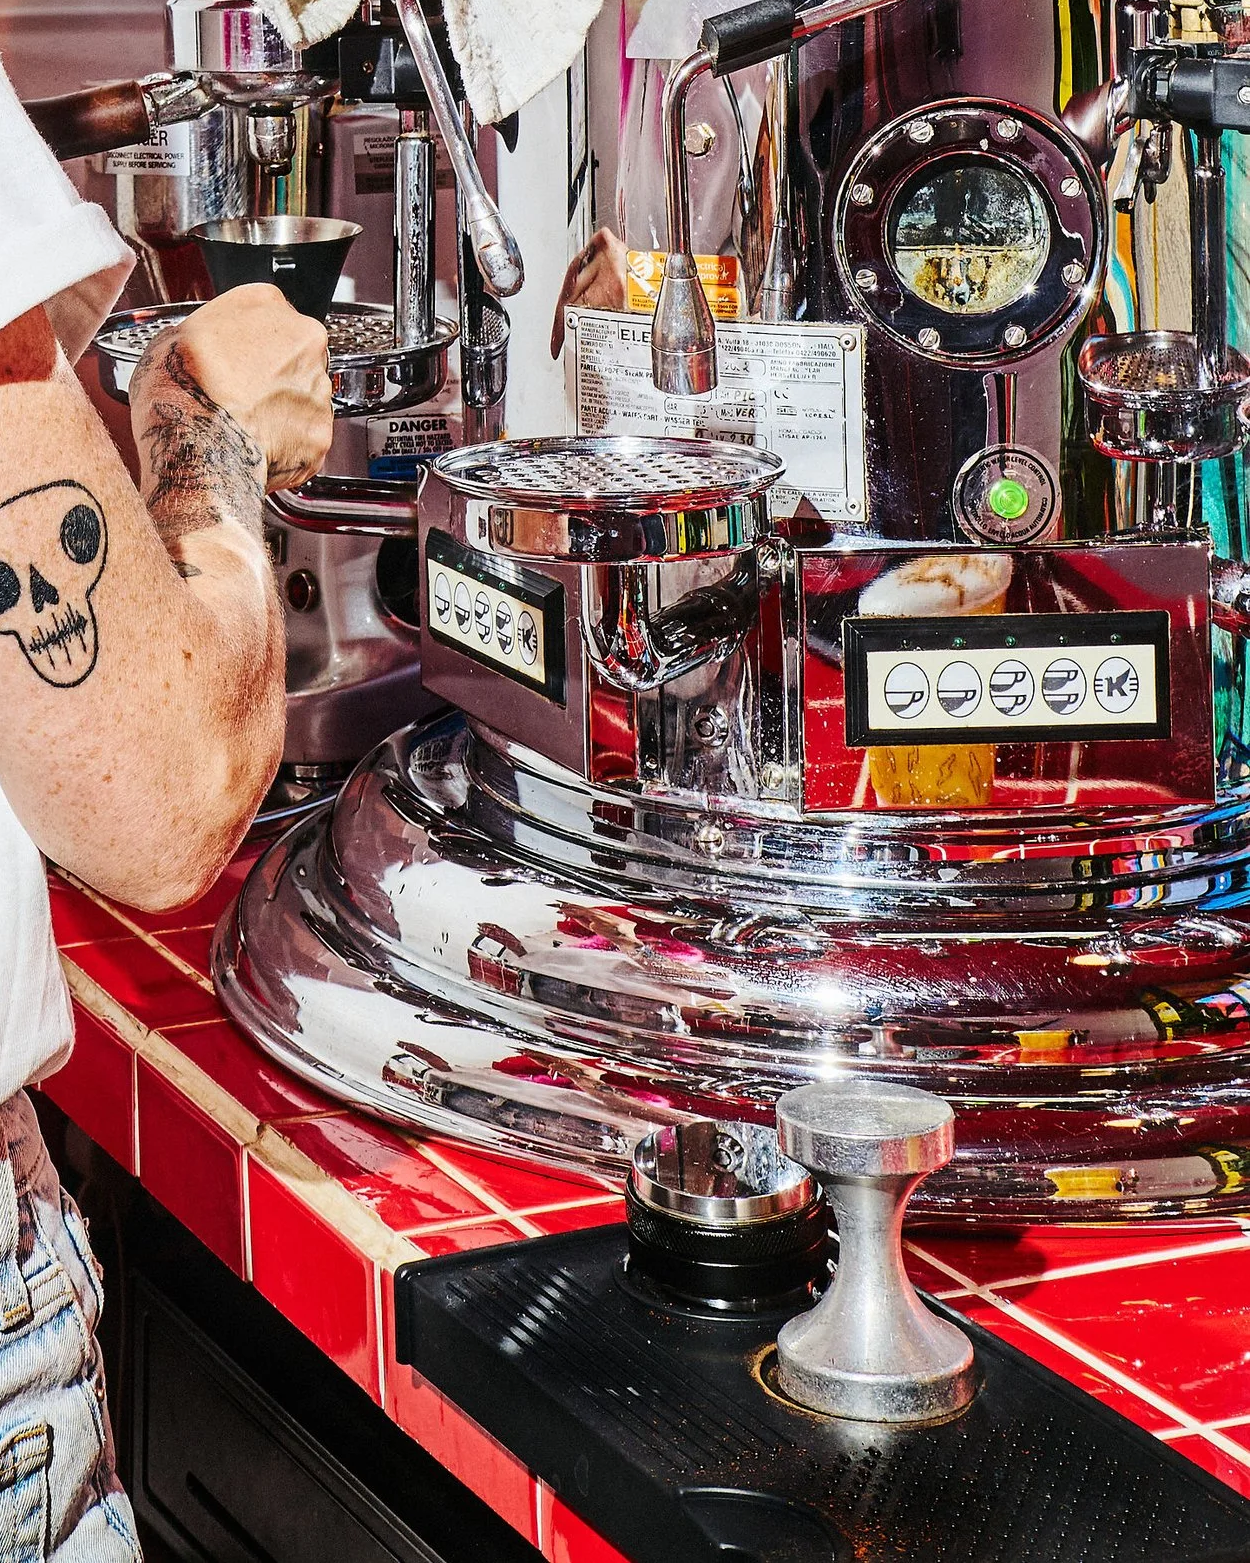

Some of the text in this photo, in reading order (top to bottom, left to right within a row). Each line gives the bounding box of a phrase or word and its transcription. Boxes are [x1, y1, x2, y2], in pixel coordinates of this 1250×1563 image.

[133, 152, 163, 160] ELECTRICAL
[164, 152, 185, 160] POWER
[128, 161, 147, 169] BEFORE
[147, 161, 176, 169] SERVICING
[620, 328, 652, 343] ELE
[389, 418, 448, 433] DANGER
[1011, 456, 1028, 466] LEVEL
[1027, 462, 1047, 487] CONTROL
[1011, 527, 1030, 539] ACQUA
